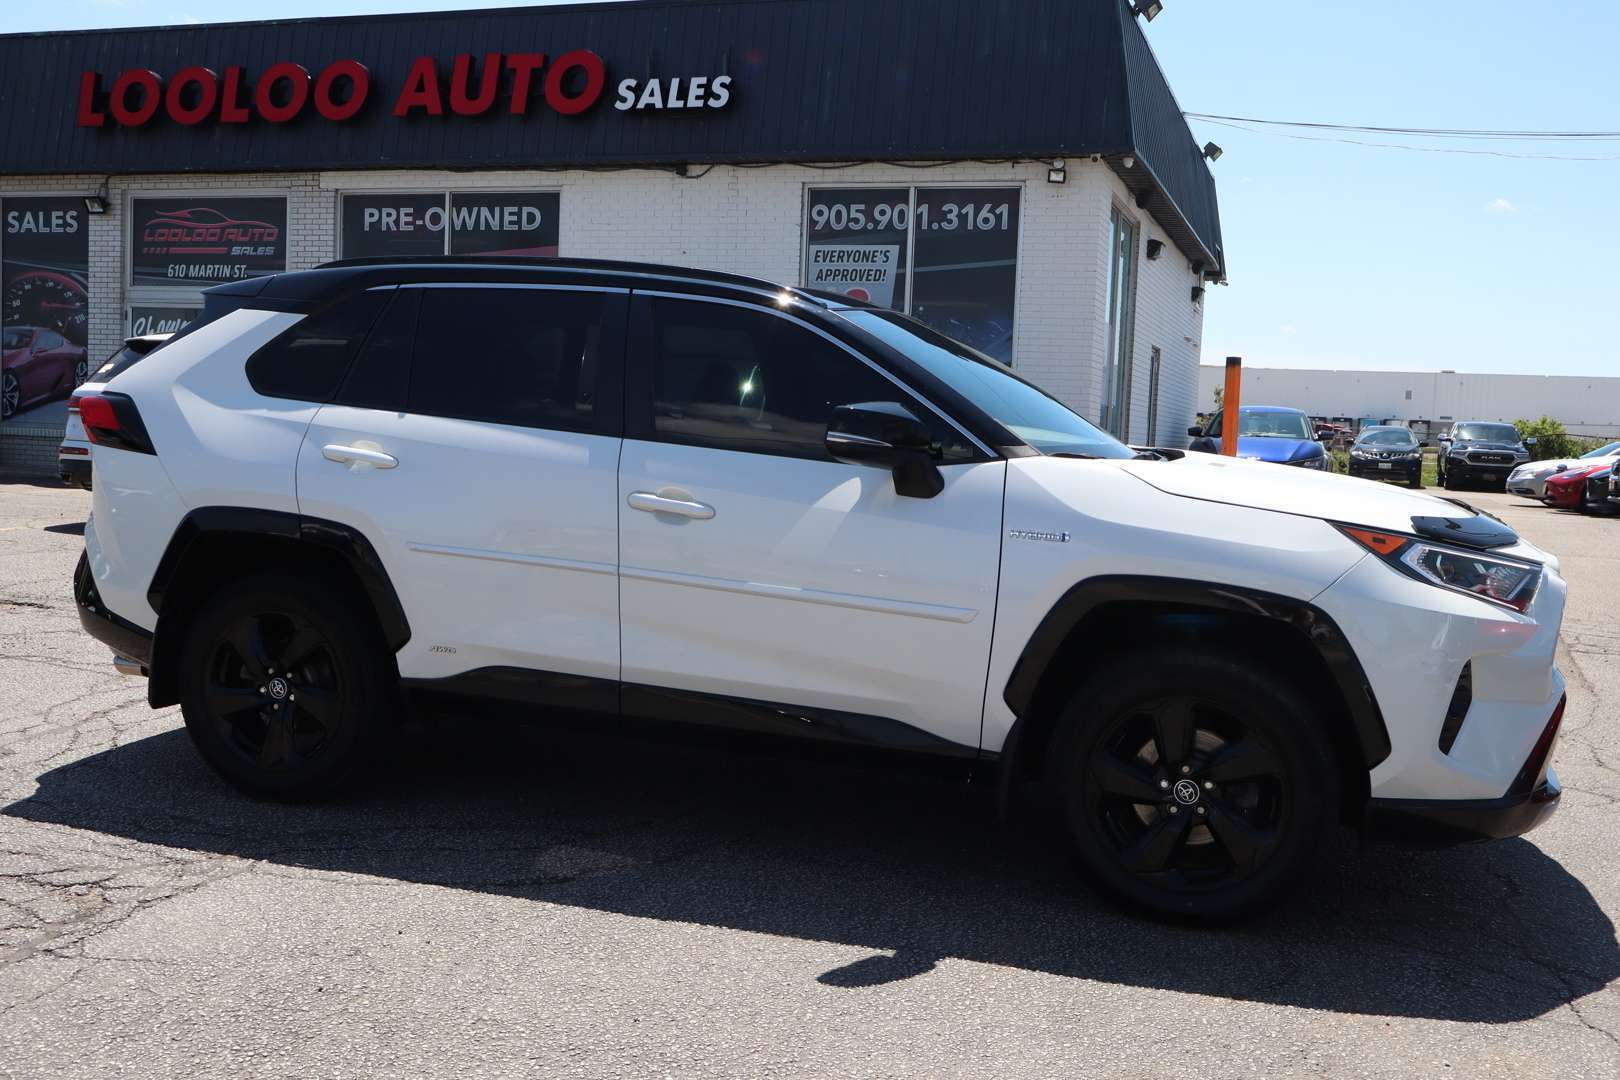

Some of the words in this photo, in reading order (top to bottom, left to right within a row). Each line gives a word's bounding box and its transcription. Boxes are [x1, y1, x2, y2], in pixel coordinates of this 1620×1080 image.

[77, 58, 369, 127] LOOLOO
[392, 49, 606, 117] AUTO
[614, 75, 733, 111] SALES
[7, 210, 79, 234] SALES
[363, 206, 542, 232] PRE-OWNED
[811, 203, 1010, 231] 905.901.3161
[143, 228, 221, 242] LOOLOO
[222, 228, 279, 242] AUTO
[813, 249, 891, 264] EVERYONE'S
[167, 264, 187, 279] 610
[188, 264, 232, 278] MARTIN
[233, 264, 249, 278] ST.
[815, 268, 888, 283] APPROVED!
